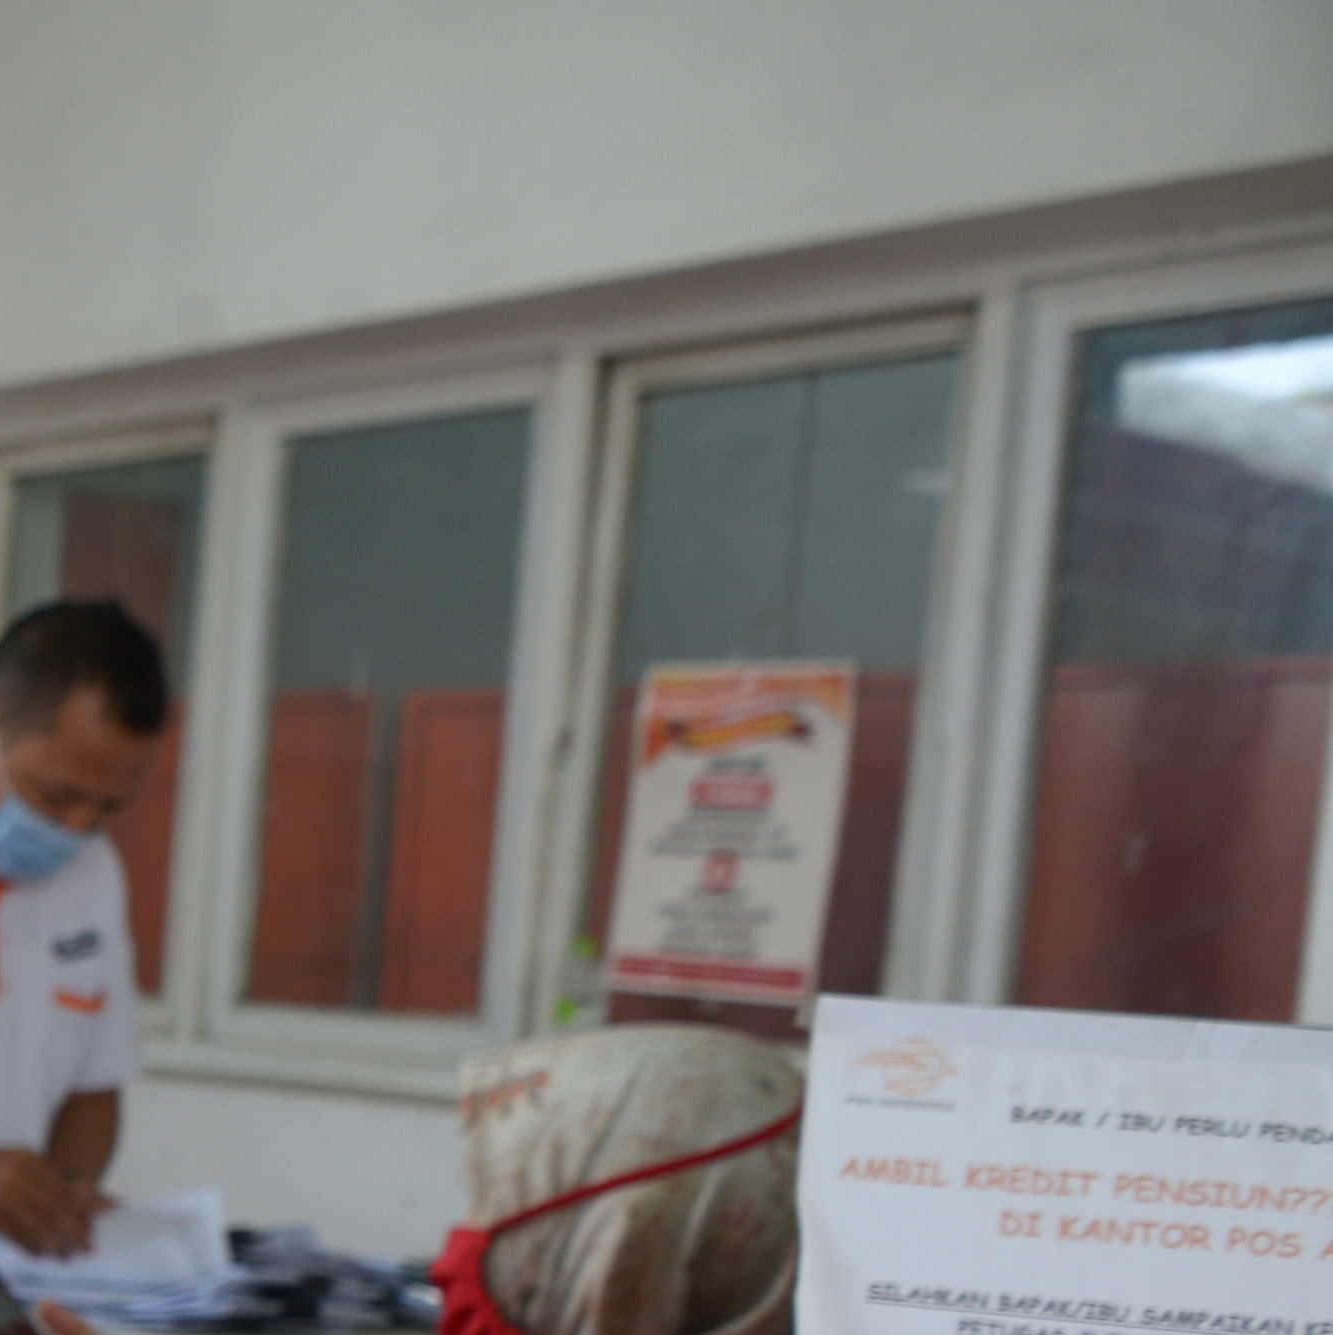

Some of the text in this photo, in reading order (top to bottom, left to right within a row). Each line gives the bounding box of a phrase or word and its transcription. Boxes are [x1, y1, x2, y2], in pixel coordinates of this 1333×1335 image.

[1010, 1106, 1087, 1127] BAPAK
[1118, 1113, 1164, 1133] IBU
[1174, 1115, 1251, 1138] PERLU
[839, 1155, 1333, 1214] AMBIL KREDIT PENSIUN??
[999, 1209, 1042, 1239] DI
[1057, 1215, 1212, 1252] KANTOR
[1226, 1226, 1304, 1259] POS
[866, 1282, 989, 1310] SILAHKAN
[998, 1293, 1132, 1325] BAPAK/IBU
[1141, 1307, 1295, 1335] SAMPAIKAN
